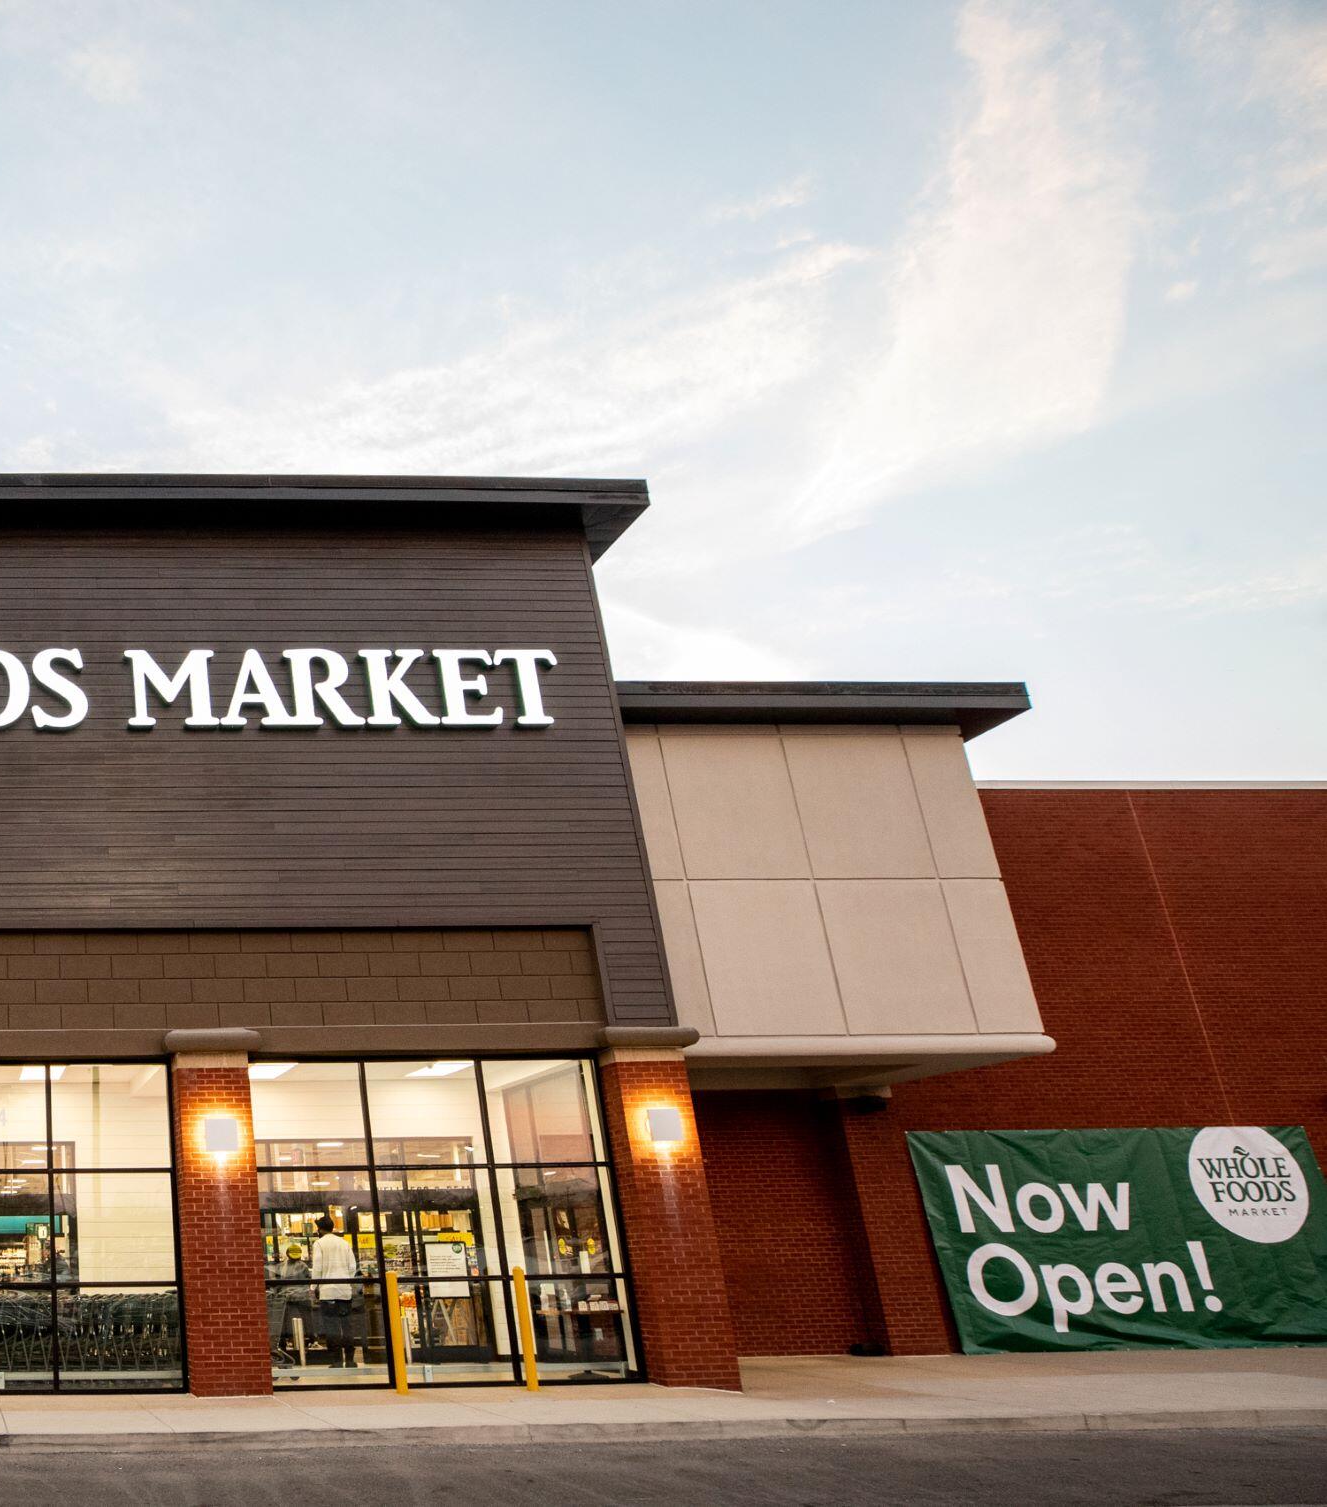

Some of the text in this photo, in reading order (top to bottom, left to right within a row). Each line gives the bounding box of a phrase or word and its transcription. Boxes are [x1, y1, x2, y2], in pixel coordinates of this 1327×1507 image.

[123, 648, 559, 731] MARKET
[1197, 1151, 1291, 1179] WHOLE
[944, 1163, 1130, 1233] Now
[1209, 1181, 1296, 1202] FOODS
[1228, 1207, 1288, 1217] MARKET
[967, 1240, 1223, 1333] Open!
